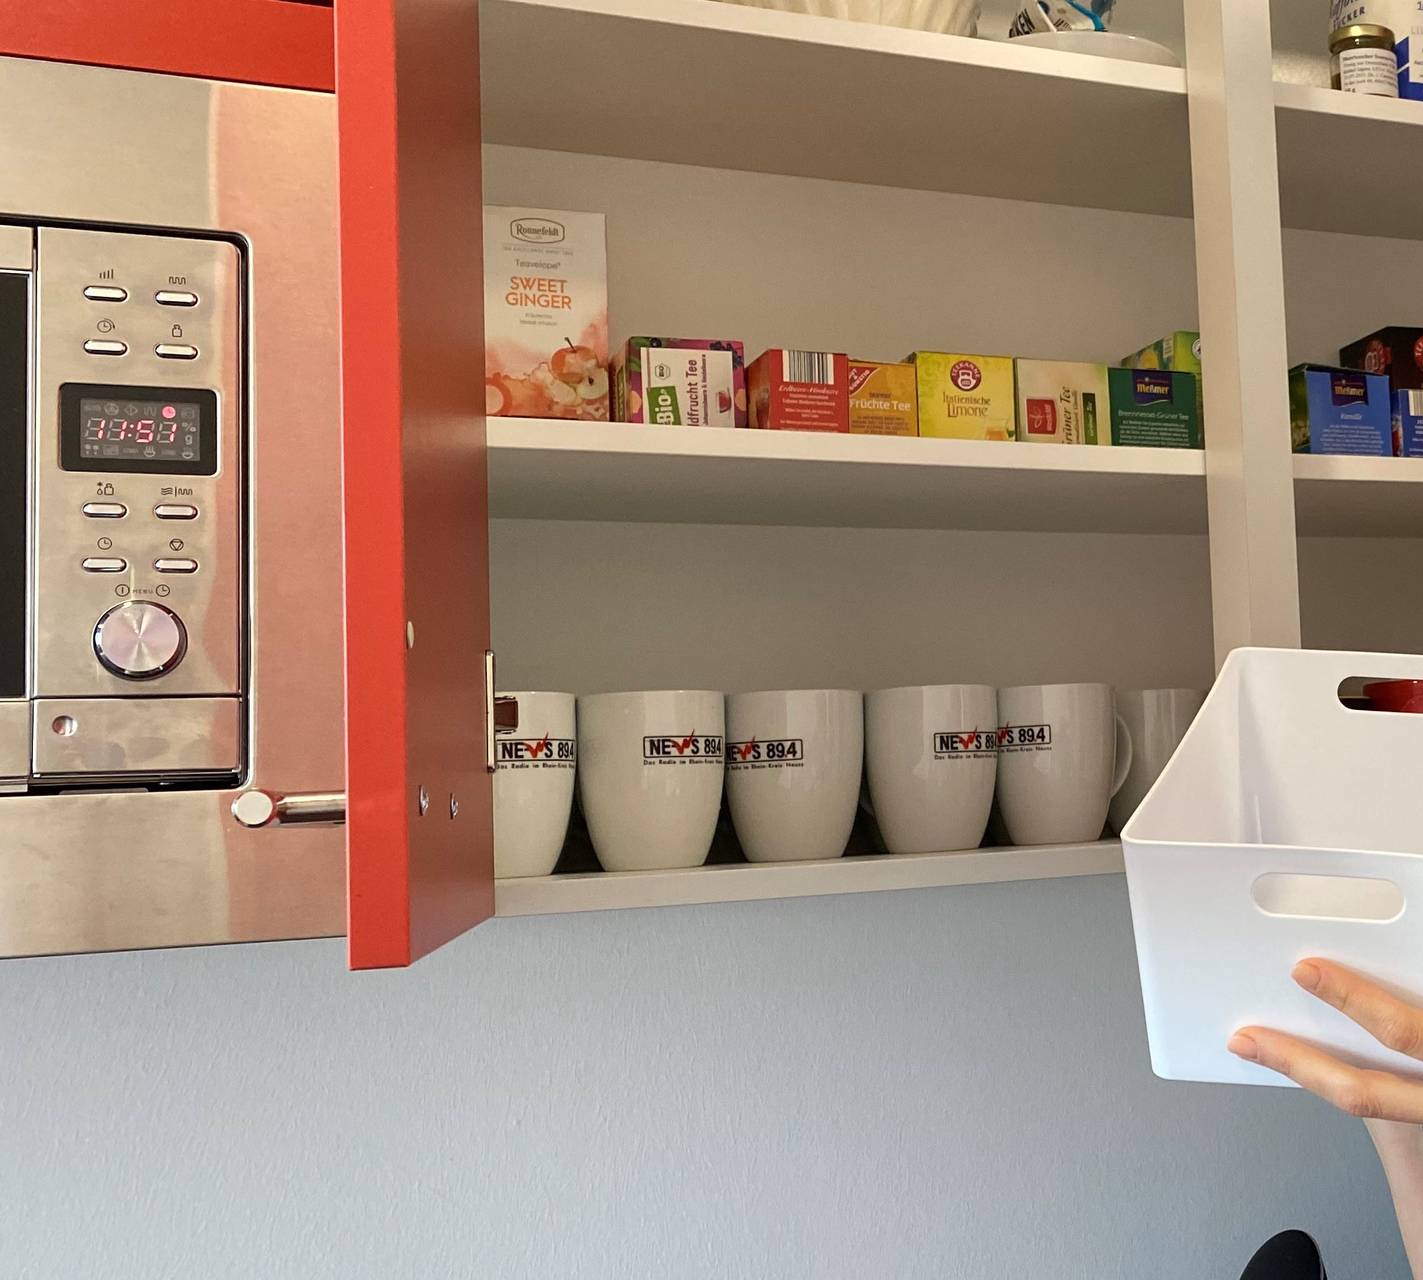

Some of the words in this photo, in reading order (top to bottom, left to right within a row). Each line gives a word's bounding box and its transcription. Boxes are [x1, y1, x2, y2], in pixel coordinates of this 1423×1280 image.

[510, 276, 568, 294] SWEET
[505, 292, 572, 310] GINGER
[686, 359, 698, 379] Tee
[1060, 386, 1071, 404] Tee
[687, 382, 700, 427] ldfrucht
[892, 400, 911, 412] Tee
[947, 403, 989, 418] Limone
[90, 418, 178, 444] 11:51
[1018, 728, 1046, 744] 89.4
[558, 741, 574, 759] 89.4
[704, 738, 721, 755] 89.4
[766, 742, 797, 759] 89.4
